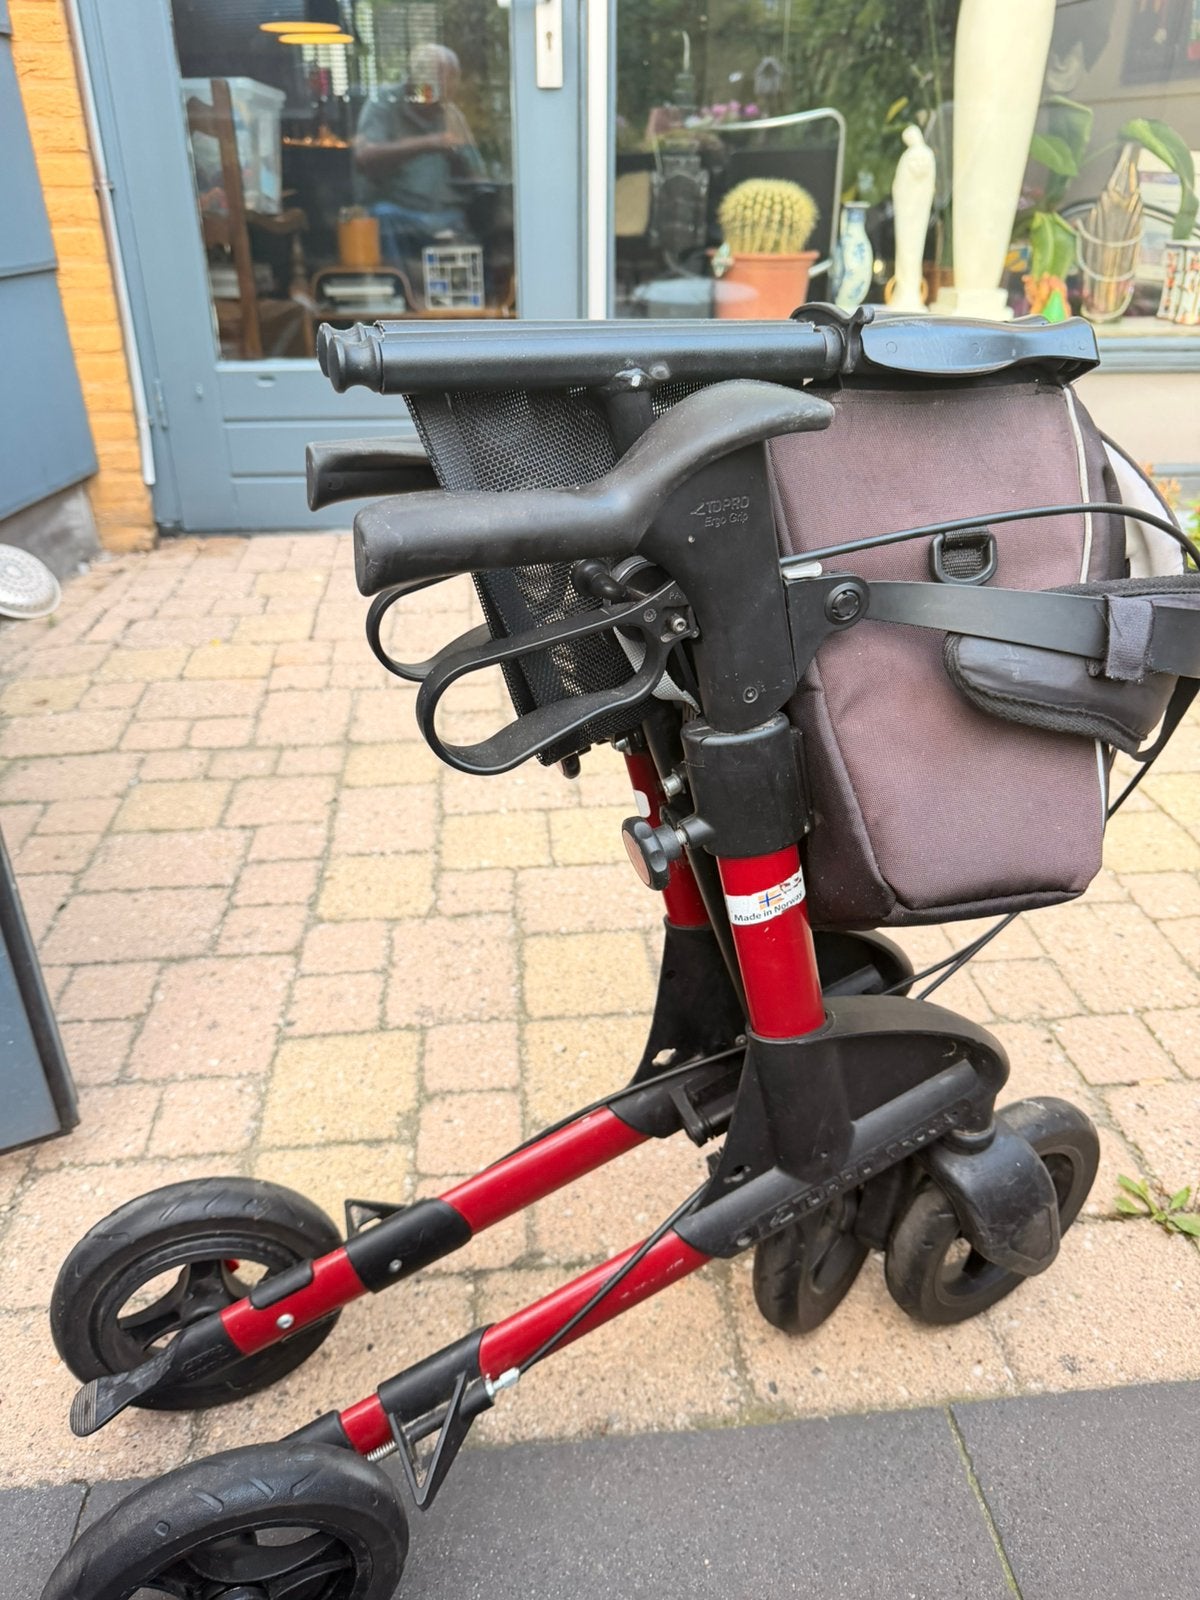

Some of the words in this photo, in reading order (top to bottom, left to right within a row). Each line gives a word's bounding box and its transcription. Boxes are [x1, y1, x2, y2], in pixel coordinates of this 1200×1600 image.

[704, 516, 727, 528] Ergo
[729, 511, 749, 524] Grip
[733, 910, 761, 922] Made
[763, 909, 773, 917] in
[774, 890, 803, 914] Norway
